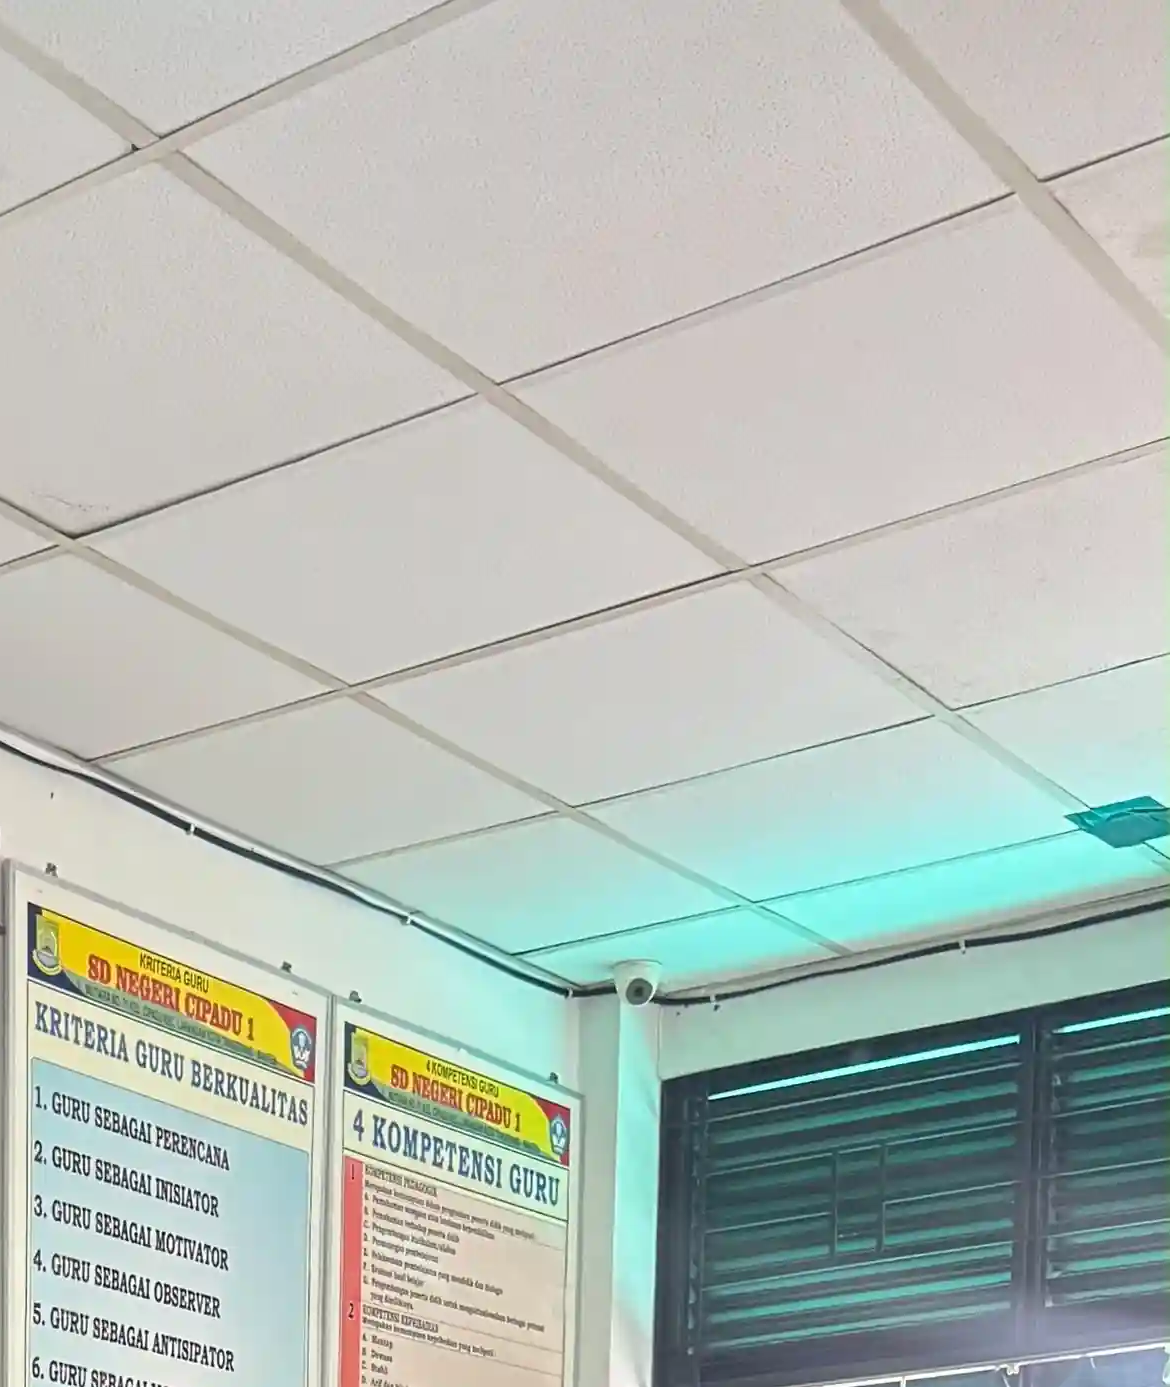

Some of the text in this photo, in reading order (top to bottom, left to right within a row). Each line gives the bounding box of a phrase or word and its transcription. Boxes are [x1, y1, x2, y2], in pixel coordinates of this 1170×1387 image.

[87, 953, 111, 984] SD
[114, 963, 180, 1012] NEGERI
[184, 992, 243, 1034] CIPADU
[247, 1017, 254, 1041] 1
[139, 953, 209, 993] KRITERIA GURU
[35, 1001, 129, 1063] KRITERIA
[135, 1039, 184, 1082] GURU
[191, 1059, 308, 1126] BERKUALITAS
[390, 1064, 408, 1090] SD
[412, 1072, 462, 1112] NEGERI
[465, 1092, 512, 1129] CIPADU
[515, 1113, 521, 1132] 1
[432, 1063, 477, 1090] KOMPETENSI
[478, 1079, 499, 1098] GURU
[35, 1086, 230, 1171] 1. GURU SEBAGAI PERENCANA
[352, 1109, 364, 1142] 4
[373, 1114, 503, 1189] KOMPETENSI
[510, 1163, 560, 1206] GURU
[34, 1140, 219, 1217] 2. GURU SEBAGAI INISIATOR
[34, 1195, 229, 1271] 3. GURU SEBAGAI MOTIVATOR
[33, 1249, 221, 1319] 4. GURU SEBAGAI OBSERVER
[32, 1303, 234, 1372] 5. GURU SEBAGAI ANTISIPATOR
[32, 1356, 44, 1380] 6.
[49, 1360, 87, 1387] GURU
